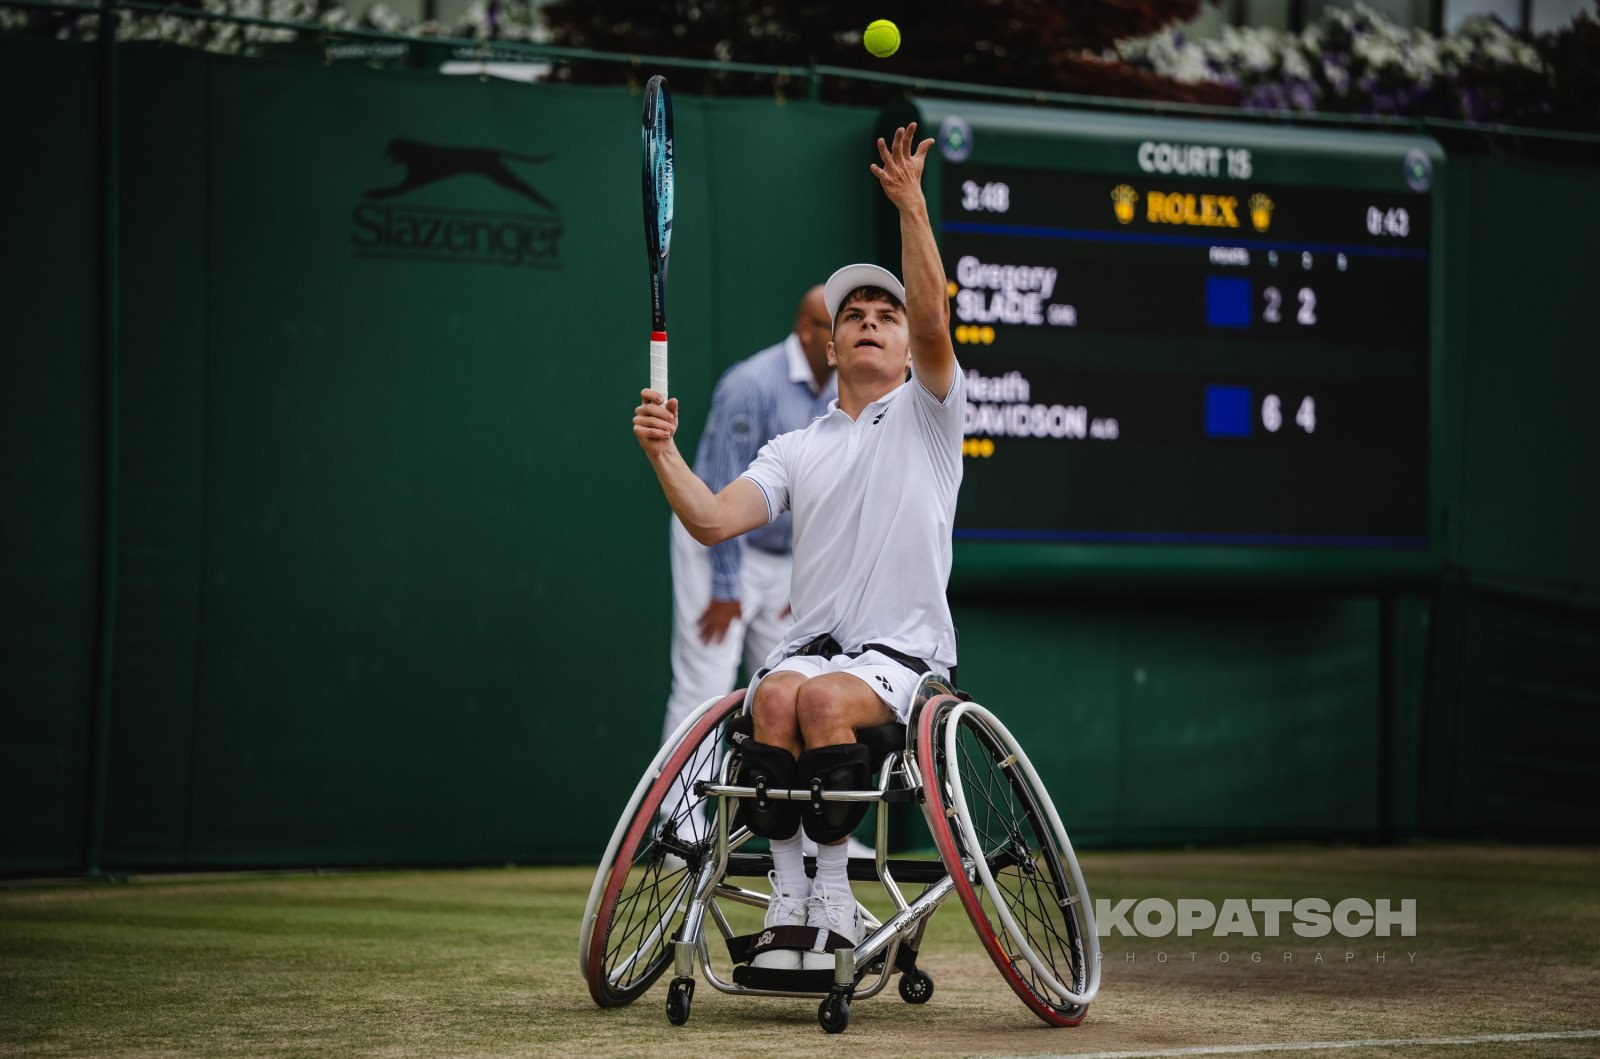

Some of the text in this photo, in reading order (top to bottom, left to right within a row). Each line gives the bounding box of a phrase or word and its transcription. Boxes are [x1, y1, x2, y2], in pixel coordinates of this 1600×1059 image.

[1138, 141, 1252, 178] COURT 15
[962, 180, 1010, 213] 3:48
[1146, 191, 1239, 228] ROLEX
[351, 203, 565, 267] Slazenger
[1366, 206, 1409, 237] 0:43
[957, 255, 1057, 299] Gregory
[956, 289, 1044, 325] SLADE
[1264, 287, 1317, 325] 2 2
[963, 402, 1088, 439] DAVIDSON
[1261, 394, 1316, 434] 6 4
